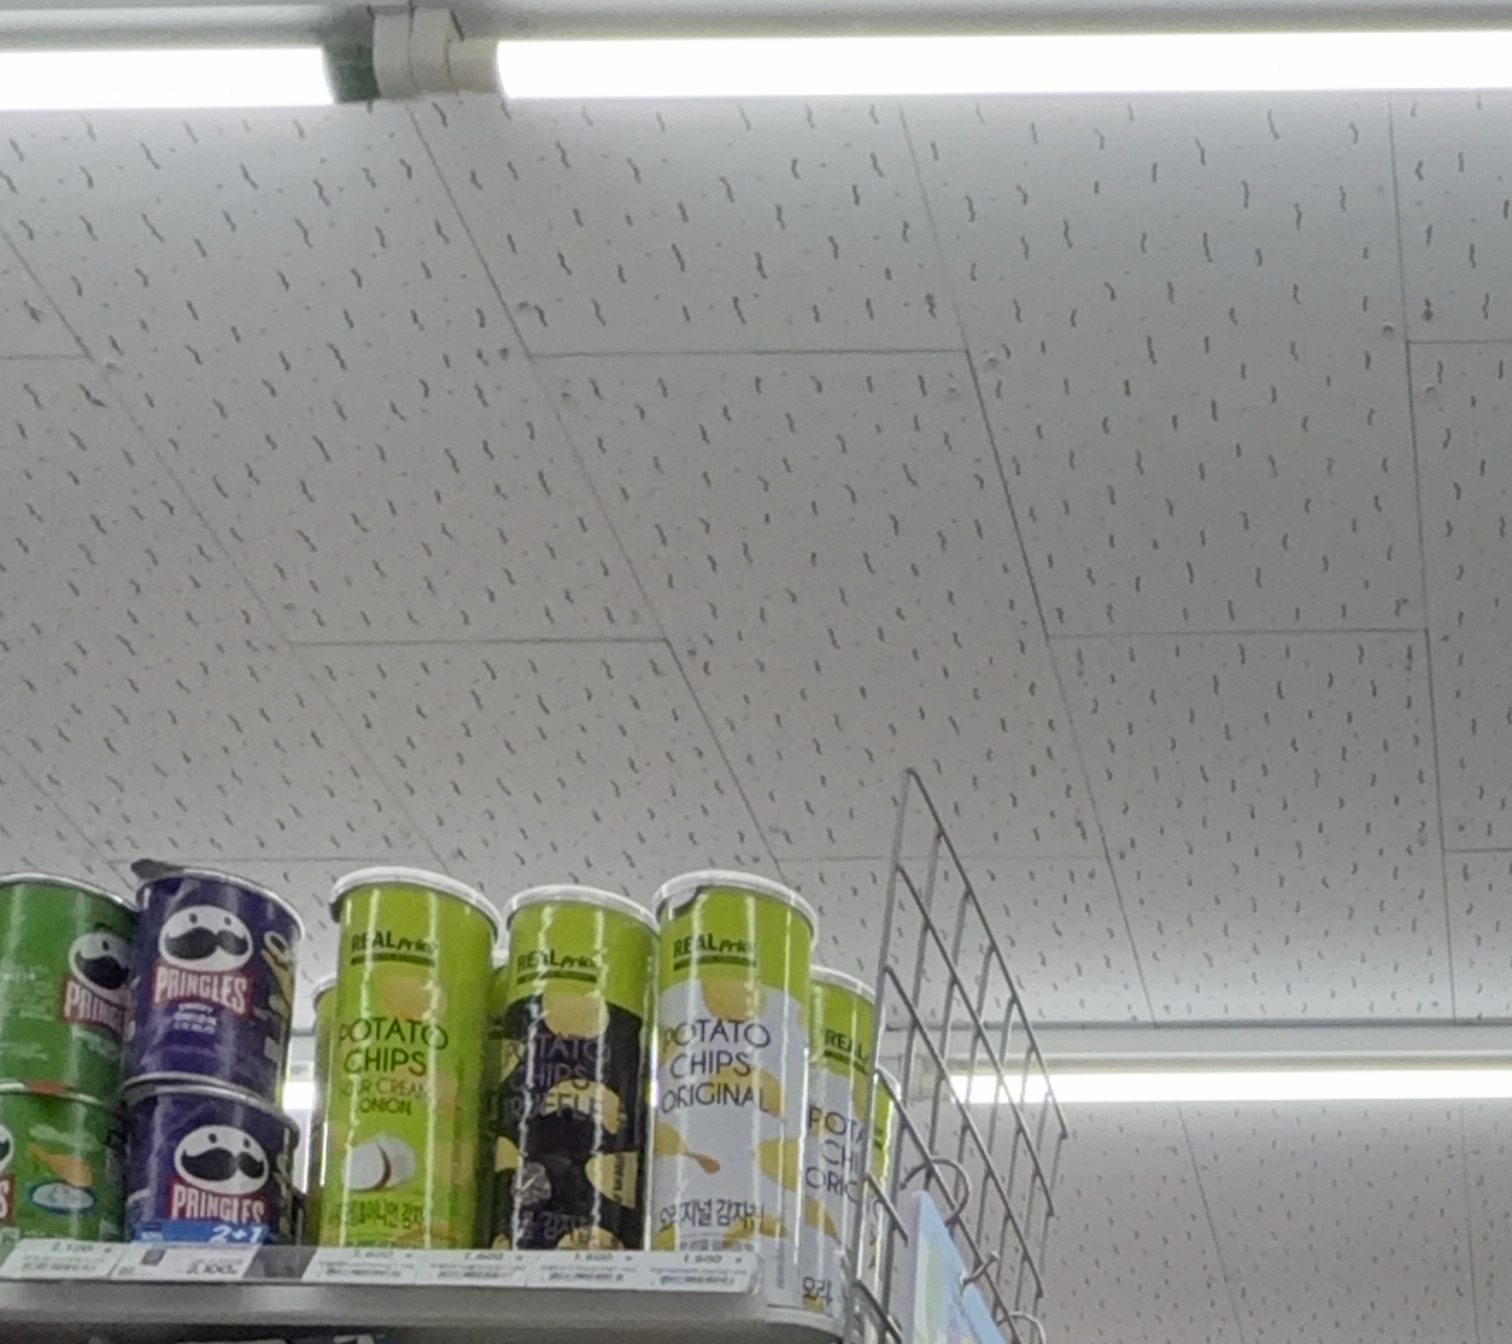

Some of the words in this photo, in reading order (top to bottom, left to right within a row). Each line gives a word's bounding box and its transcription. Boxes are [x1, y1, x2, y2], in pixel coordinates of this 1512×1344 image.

[154, 965, 249, 1016] PRINGLES
[339, 1018, 449, 1049] POTATO
[661, 1018, 771, 1050] POTATO
[344, 1048, 428, 1077] CHIPS
[669, 1050, 752, 1081] CHIPS
[660, 1081, 770, 1114] ORIGINAL
[807, 1104, 866, 1143] POTA
[820, 1140, 860, 1169] CHI
[171, 1183, 267, 1224] PRINGLES
[209, 1226, 263, 1244] 2+1
